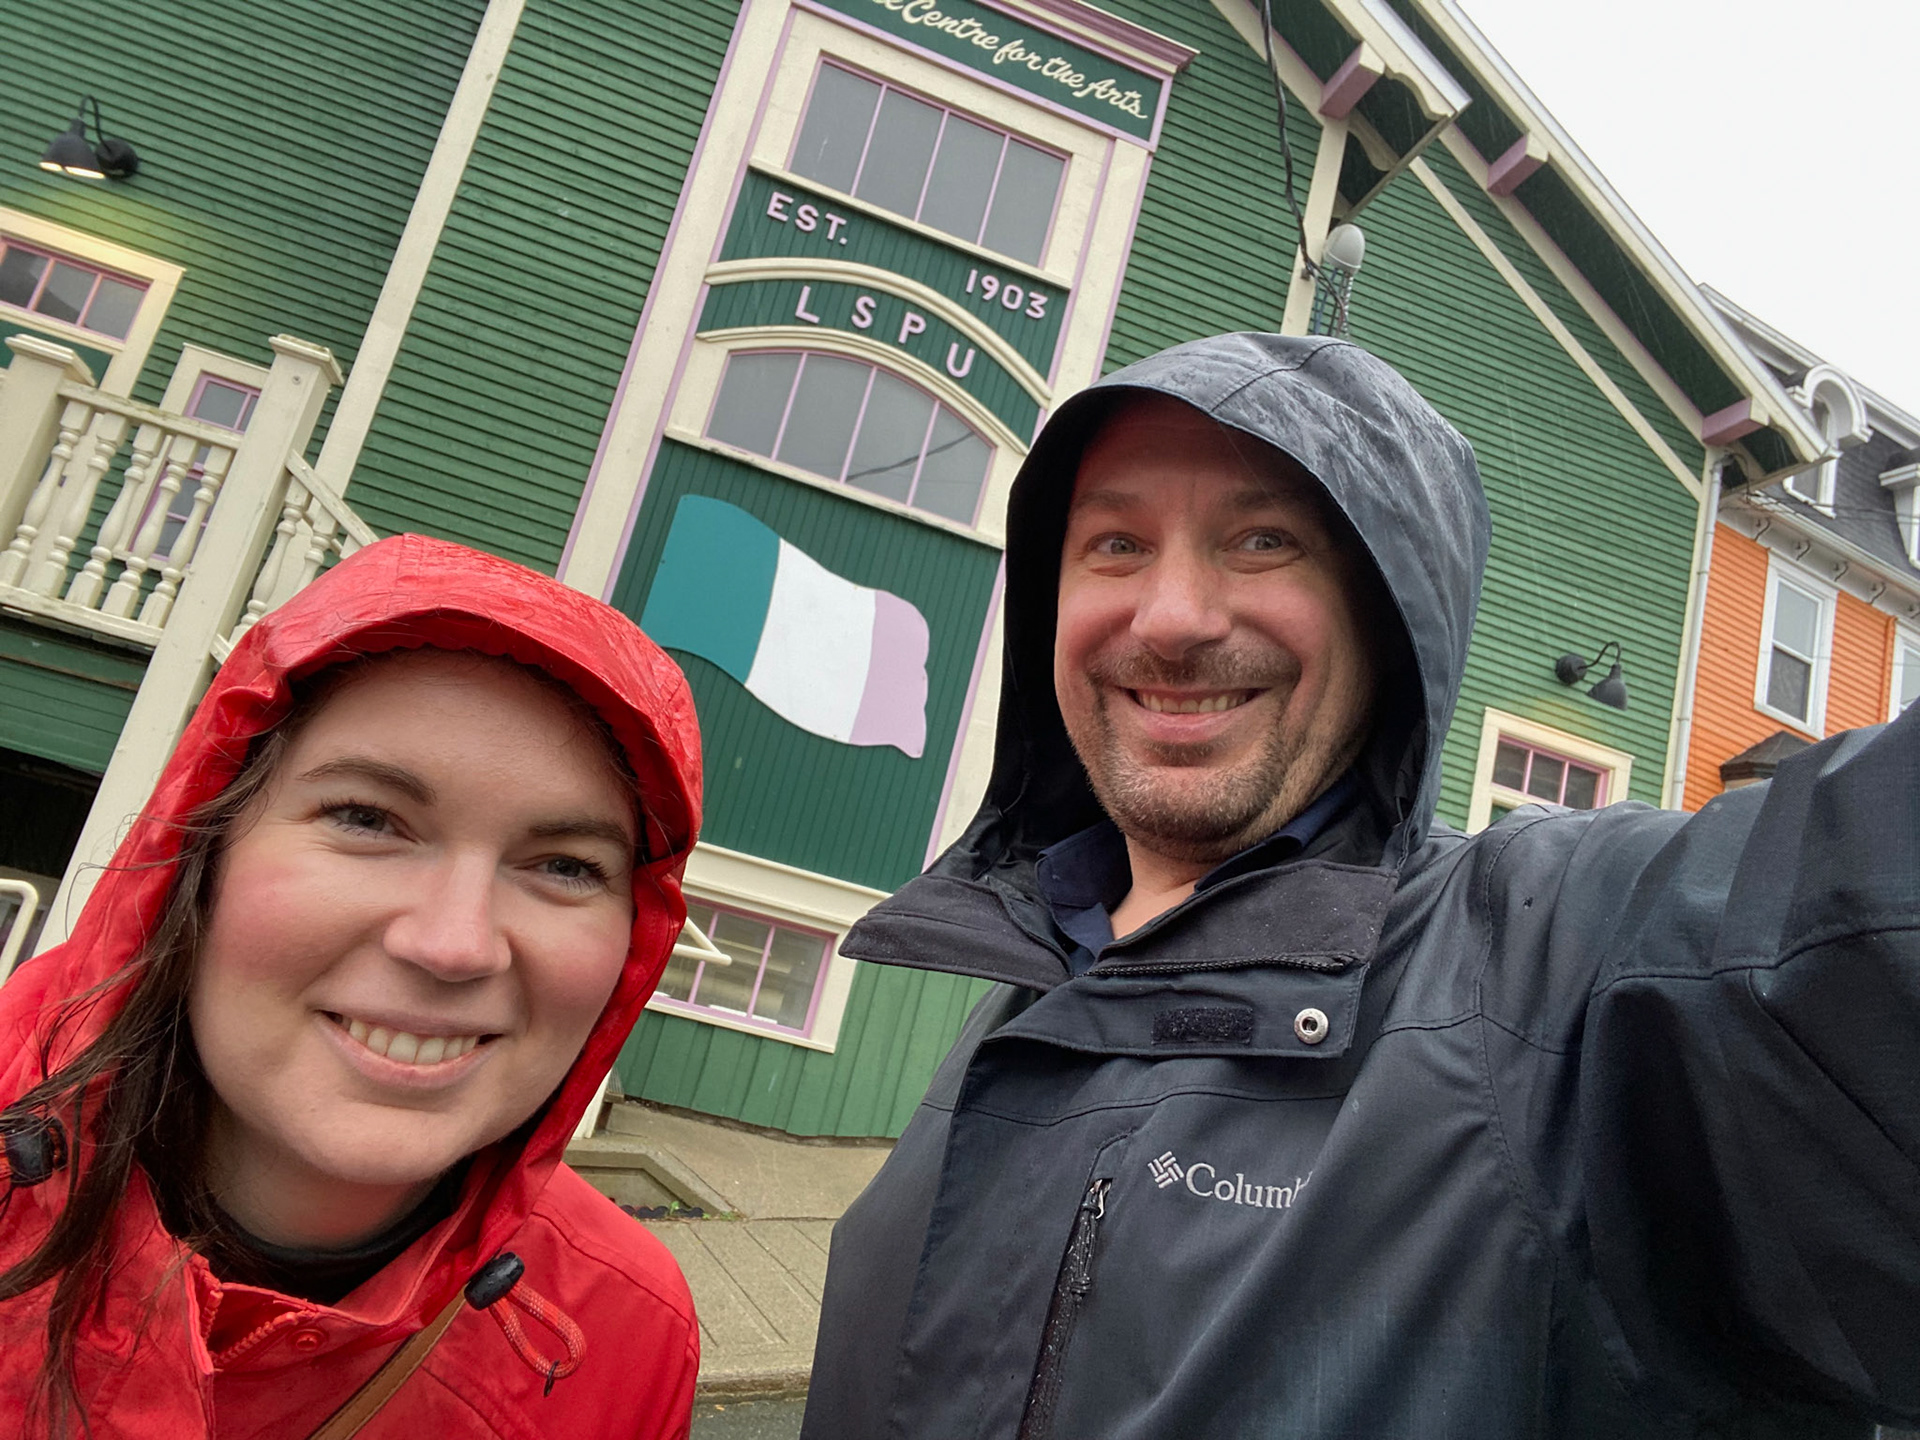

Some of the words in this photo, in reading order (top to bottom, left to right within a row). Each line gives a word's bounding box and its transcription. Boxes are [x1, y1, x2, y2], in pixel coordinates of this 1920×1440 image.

[902, 0, 999, 49] Centre
[992, 39, 1042, 70] for
[1041, 56, 1085, 88] the
[1072, 78, 1148, 119] Arts
[767, 191, 848, 245] EST.
[965, 269, 1048, 319] 1903
